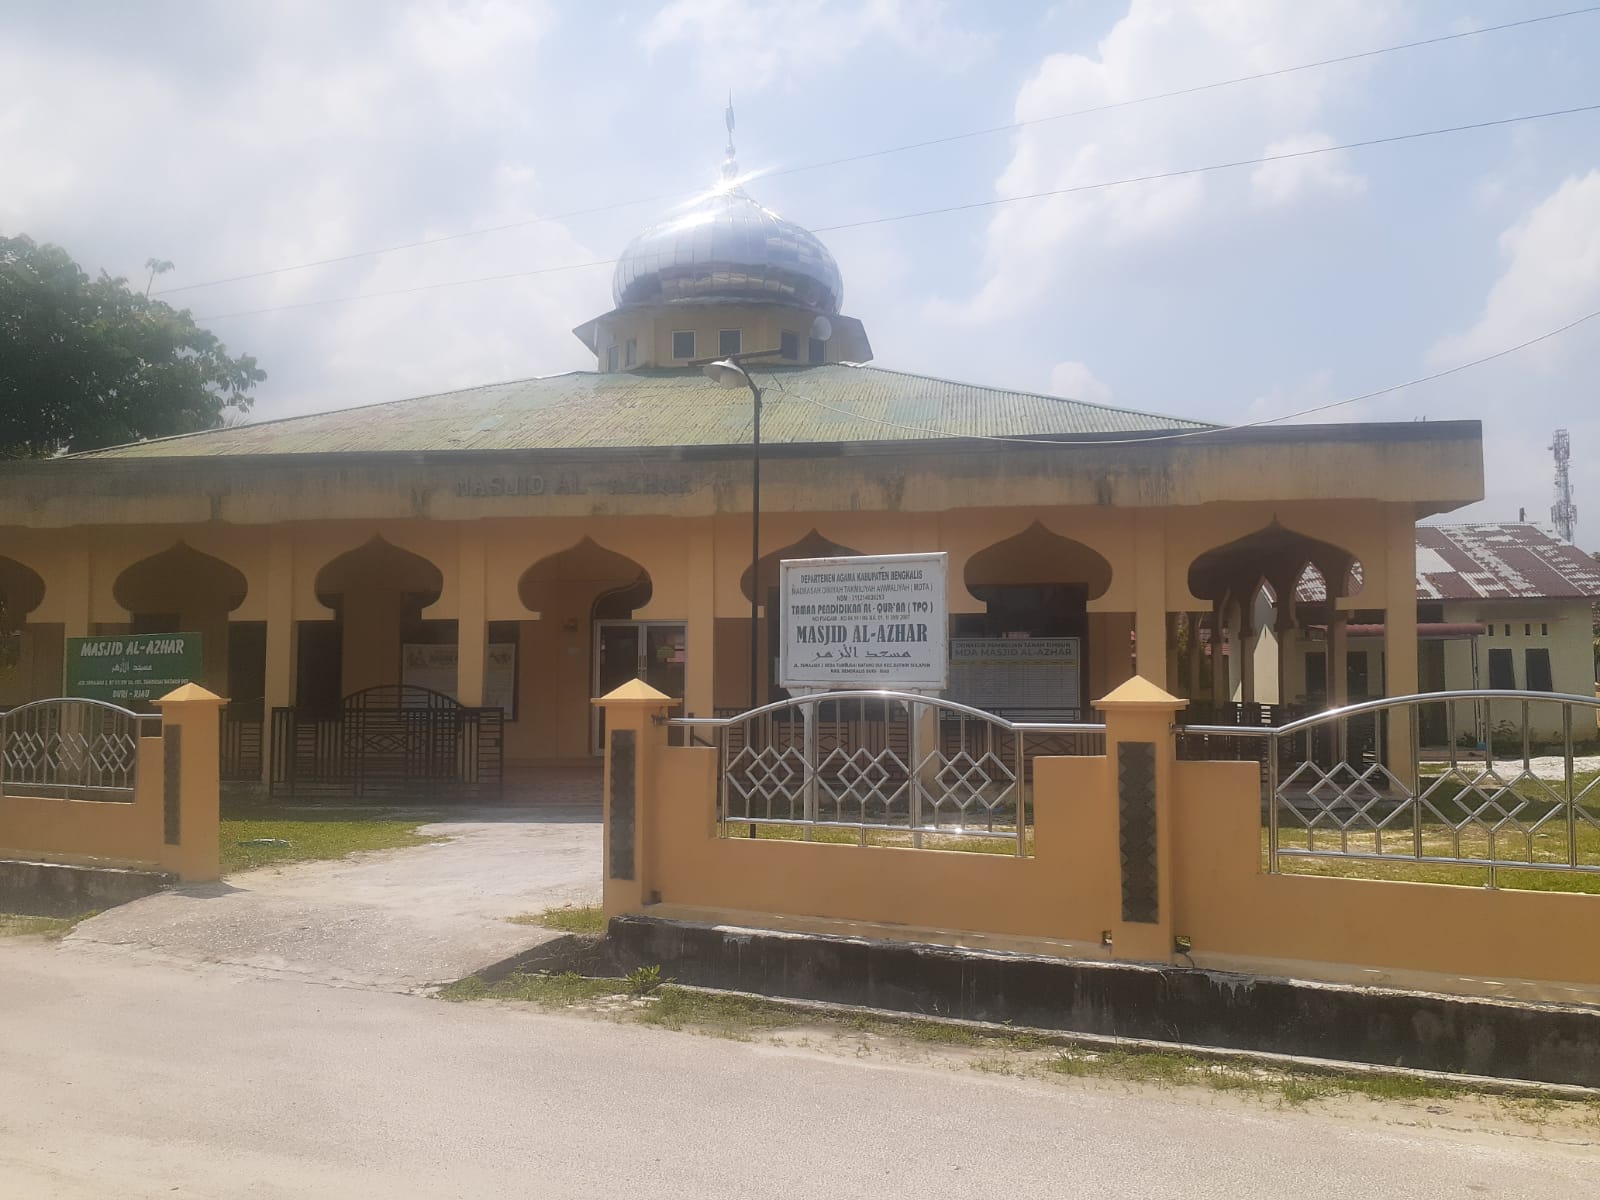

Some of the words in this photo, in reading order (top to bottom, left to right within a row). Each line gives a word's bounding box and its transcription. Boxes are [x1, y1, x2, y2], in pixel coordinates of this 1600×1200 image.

[800, 573, 836, 584] DEPARTEMEN
[836, 572, 856, 583] AGAMA
[857, 571, 890, 582] KABUPATEN
[890, 569, 923, 580] BENGKALIS
[796, 625, 848, 645] MASJID
[852, 623, 928, 643] AL-AZHAR
[126, 638, 185, 656] AL-AZHAR
[980, 649, 1018, 657] MASJID
